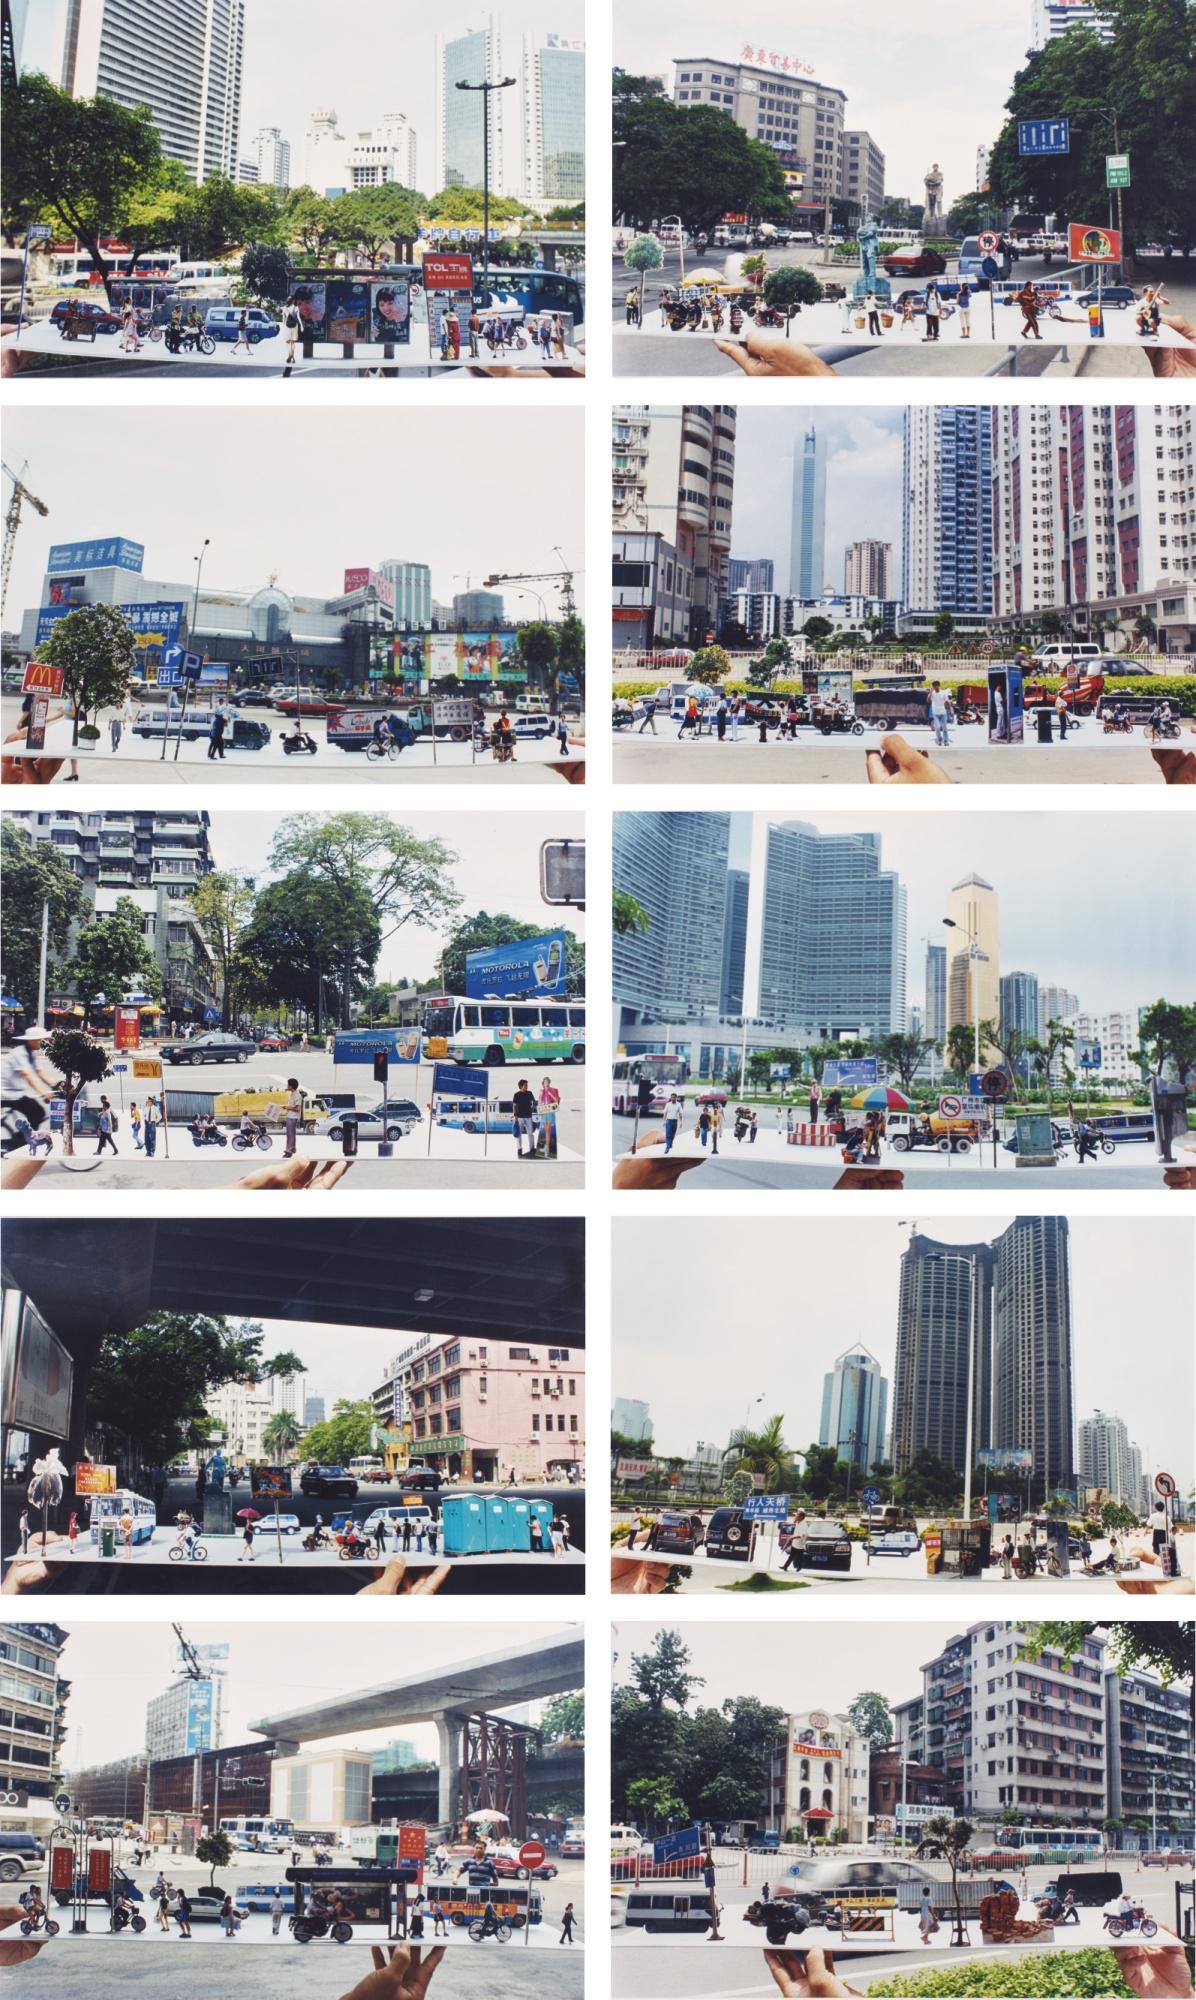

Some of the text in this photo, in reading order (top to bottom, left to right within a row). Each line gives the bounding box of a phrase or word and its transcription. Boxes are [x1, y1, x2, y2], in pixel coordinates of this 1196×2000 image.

[425, 263, 449, 272] TCL
[159, 669, 183, 684] 出口
[481, 960, 530, 975] MOTOROLA
[350, 1040, 393, 1048] MOTOROLA
[747, 1496, 786, 1507] 行人天桥
